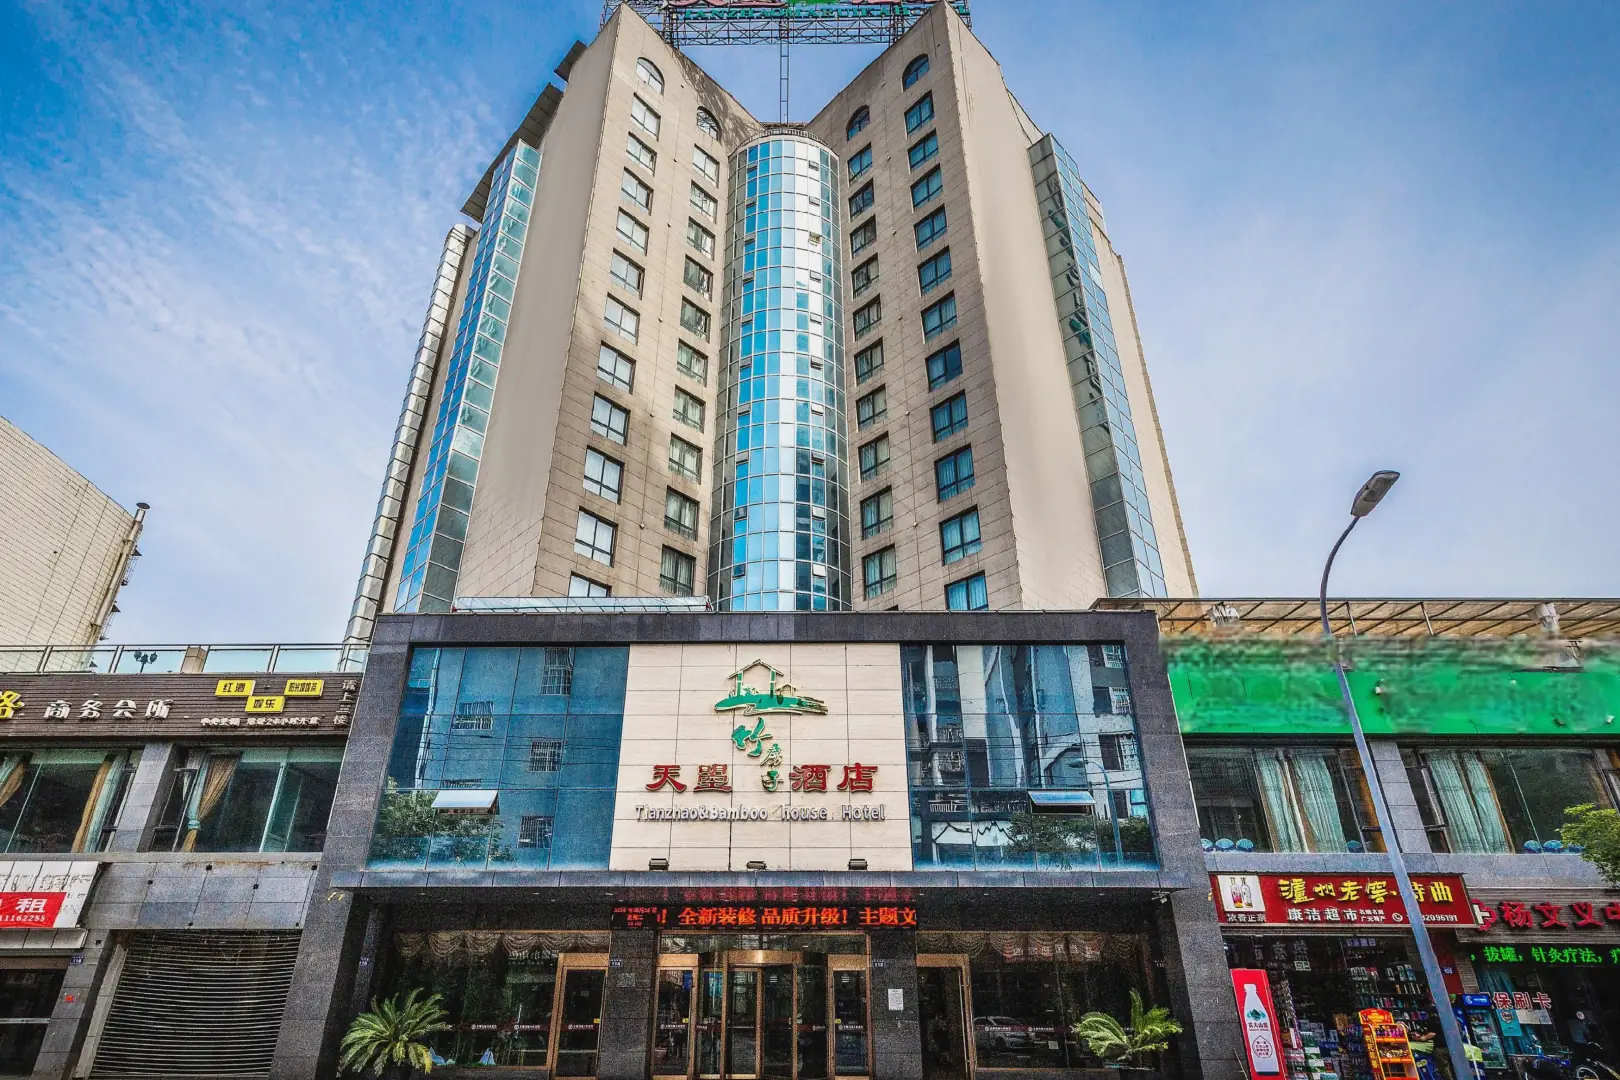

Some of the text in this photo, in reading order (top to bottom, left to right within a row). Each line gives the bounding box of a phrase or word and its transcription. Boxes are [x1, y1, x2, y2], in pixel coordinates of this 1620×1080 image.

[222, 682, 246, 693] 红酒
[43, 699, 174, 720] 商务会所
[252, 698, 276, 709] 娱乐
[788, 763, 879, 794] 酒店
[842, 803, 886, 821] Hotel
[678, 907, 757, 925] 全新装修
[859, 907, 917, 925] 主题文
[1227, 913, 1267, 922] 浓香正宗
[1287, 907, 1358, 922] 康洁超市
[1481, 991, 1553, 1010] 保刷卡
